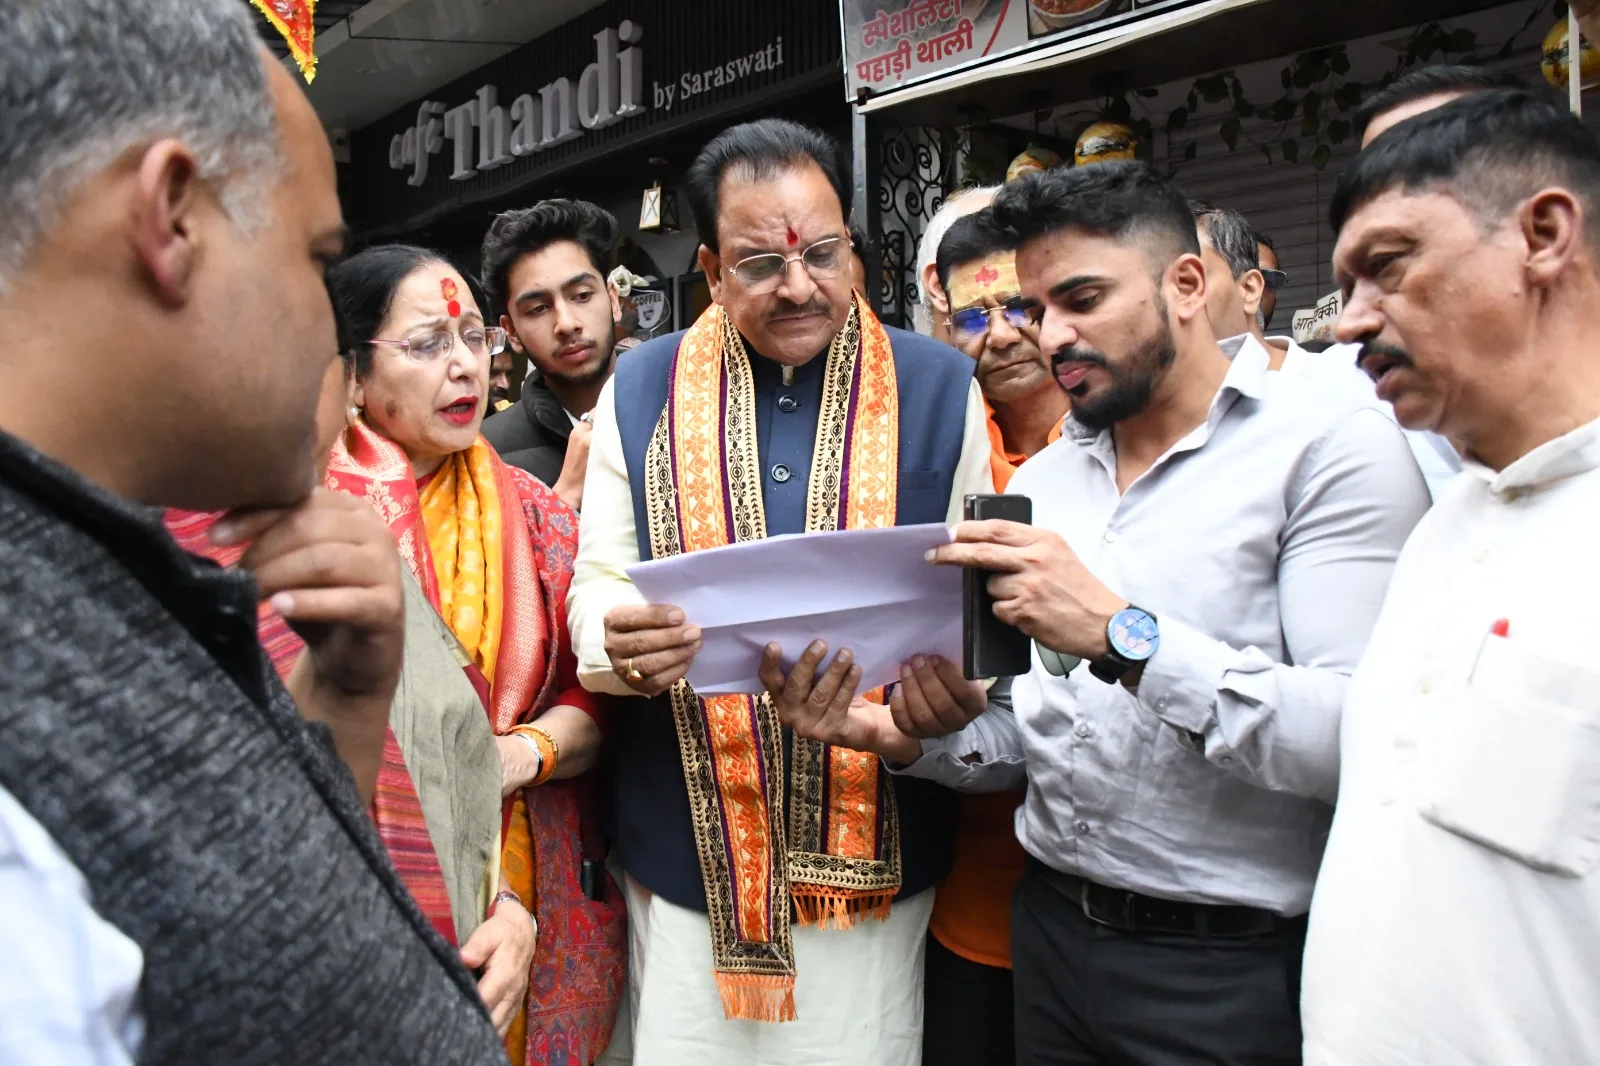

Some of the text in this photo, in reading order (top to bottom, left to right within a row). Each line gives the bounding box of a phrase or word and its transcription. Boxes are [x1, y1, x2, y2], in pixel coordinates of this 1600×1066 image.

[444, 19, 645, 181] Thandi
[653, 81, 676, 111] by
[680, 36, 784, 100] Saraswati
[856, 18, 974, 82] पहाड़ी थाली
